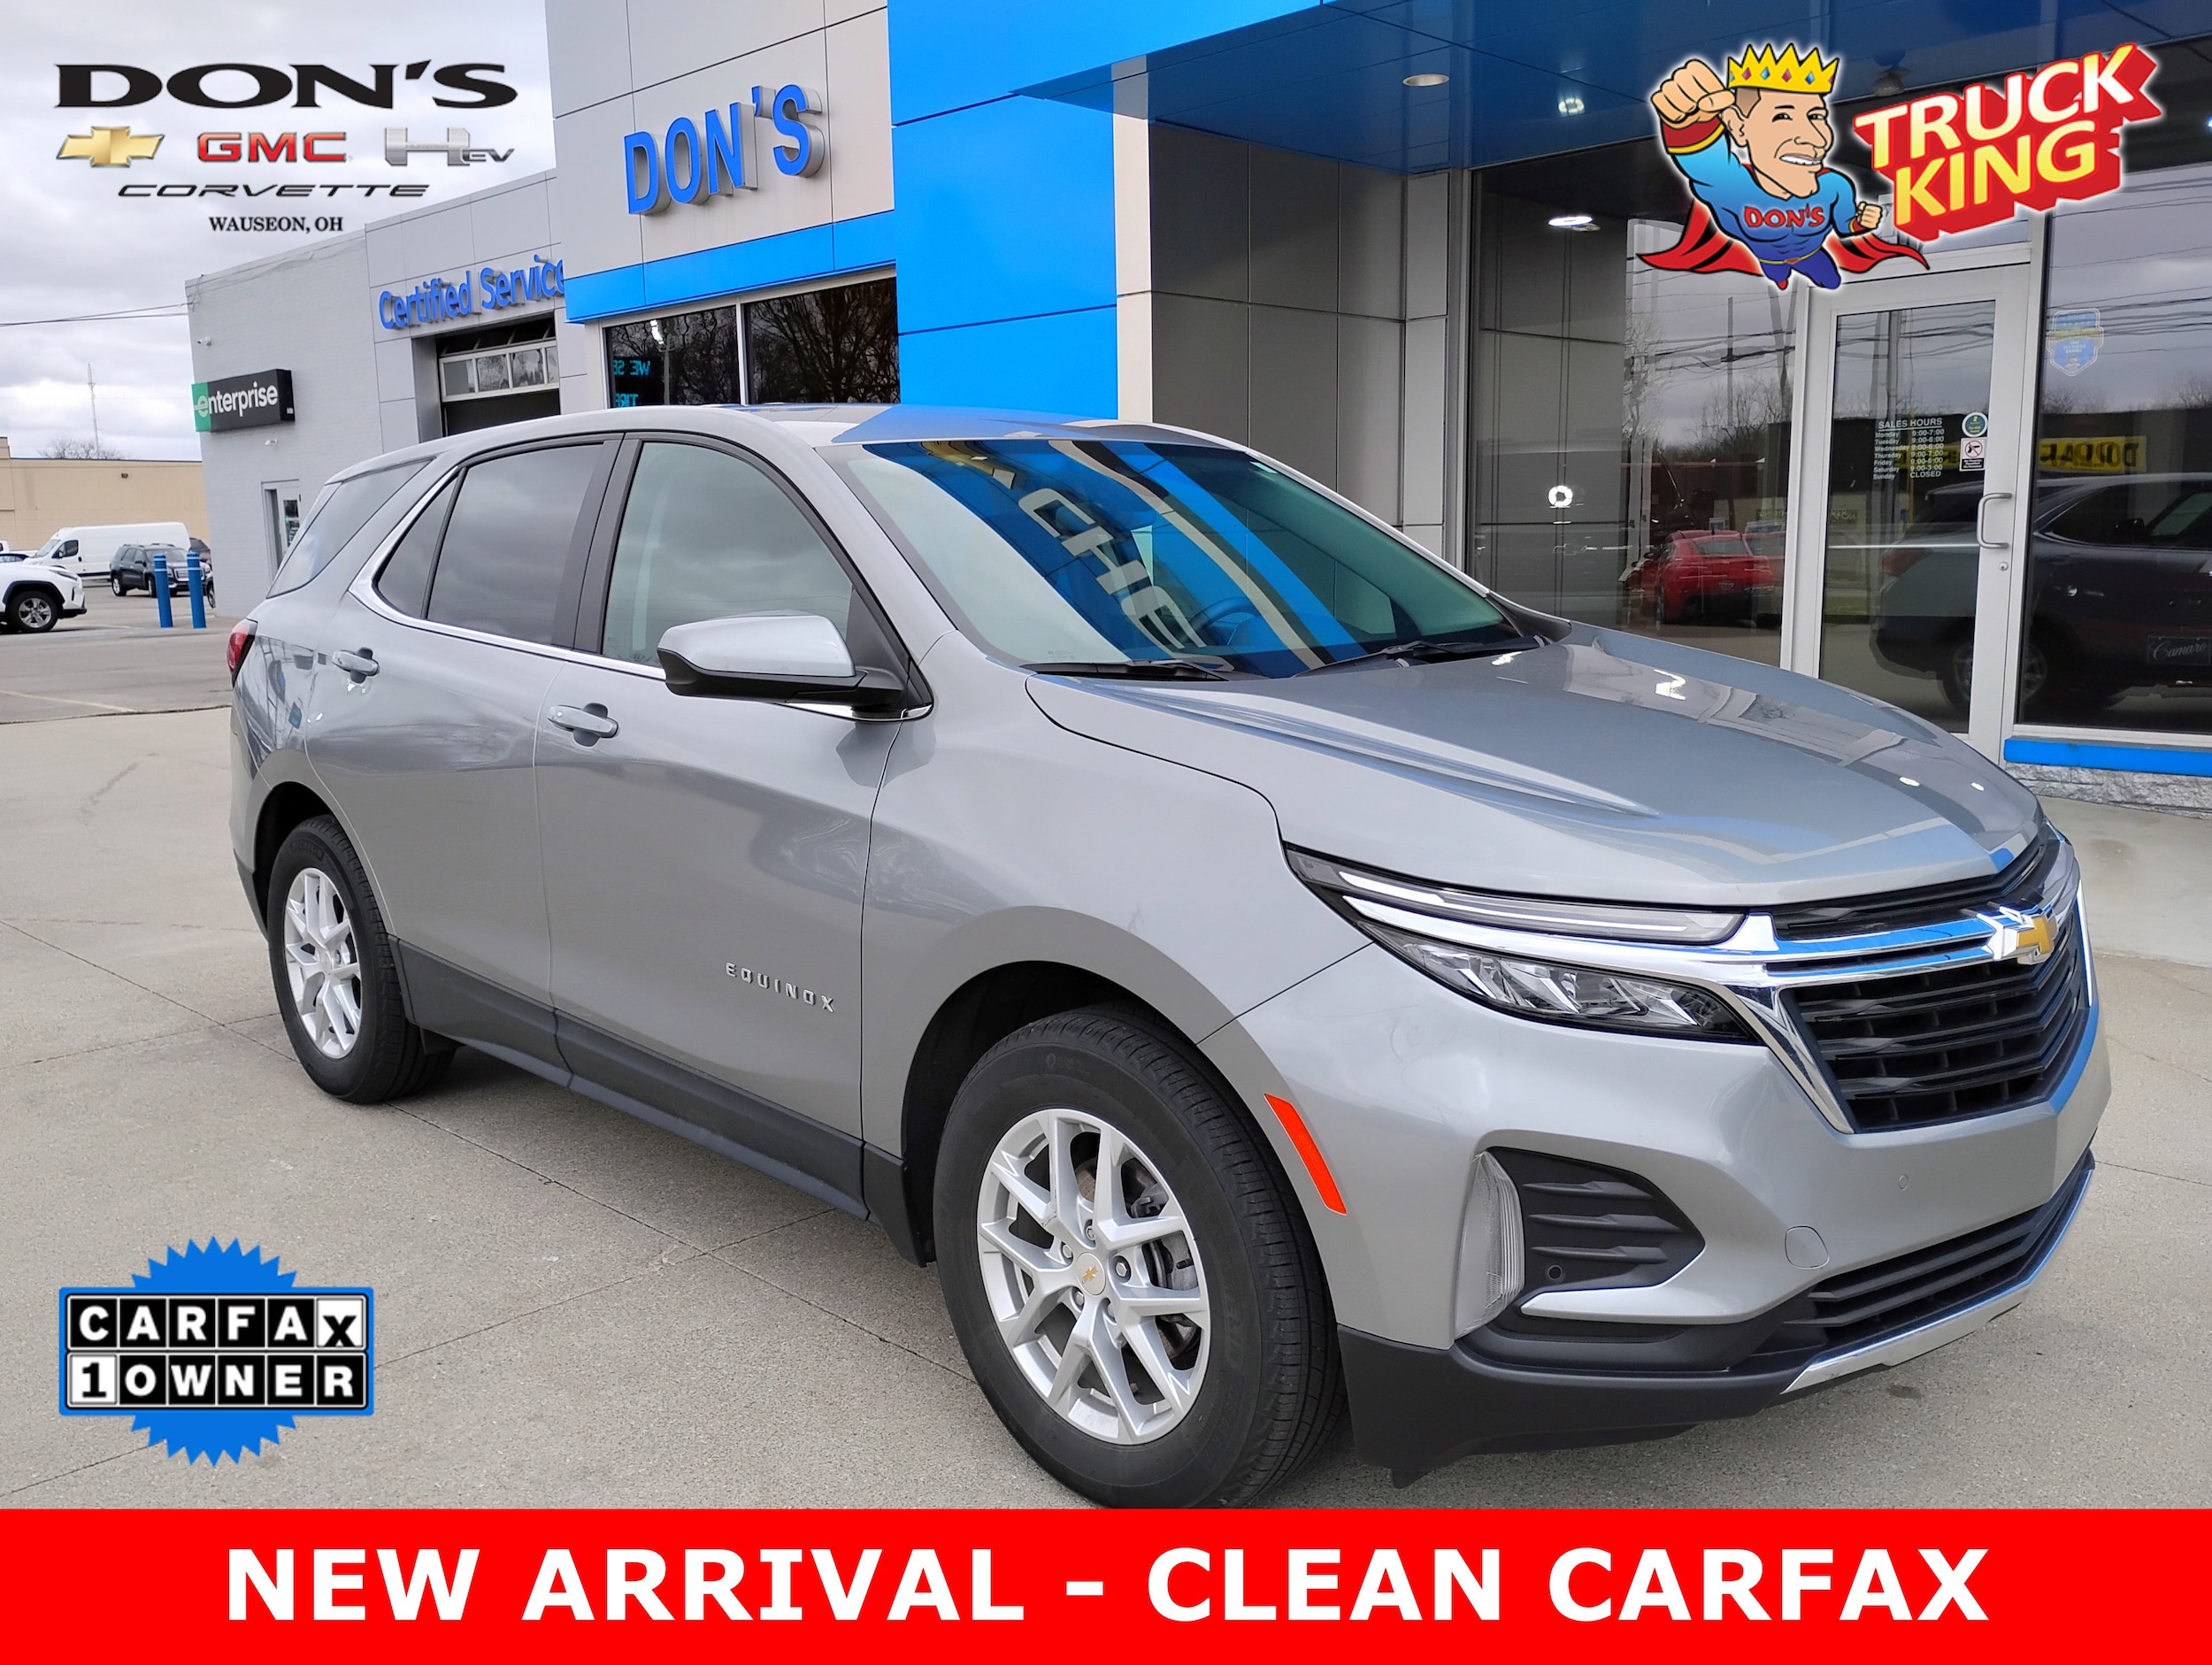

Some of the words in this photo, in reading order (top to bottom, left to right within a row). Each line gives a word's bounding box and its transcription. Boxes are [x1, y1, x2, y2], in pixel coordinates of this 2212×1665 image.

[624, 83, 819, 215] DON'S
[379, 270, 473, 330] Certified
[195, 380, 279, 418] enterprise
[1878, 419, 1908, 429] SALES
[1909, 418, 1943, 426] HOURS
[726, 961, 835, 1014] EQUINOX
